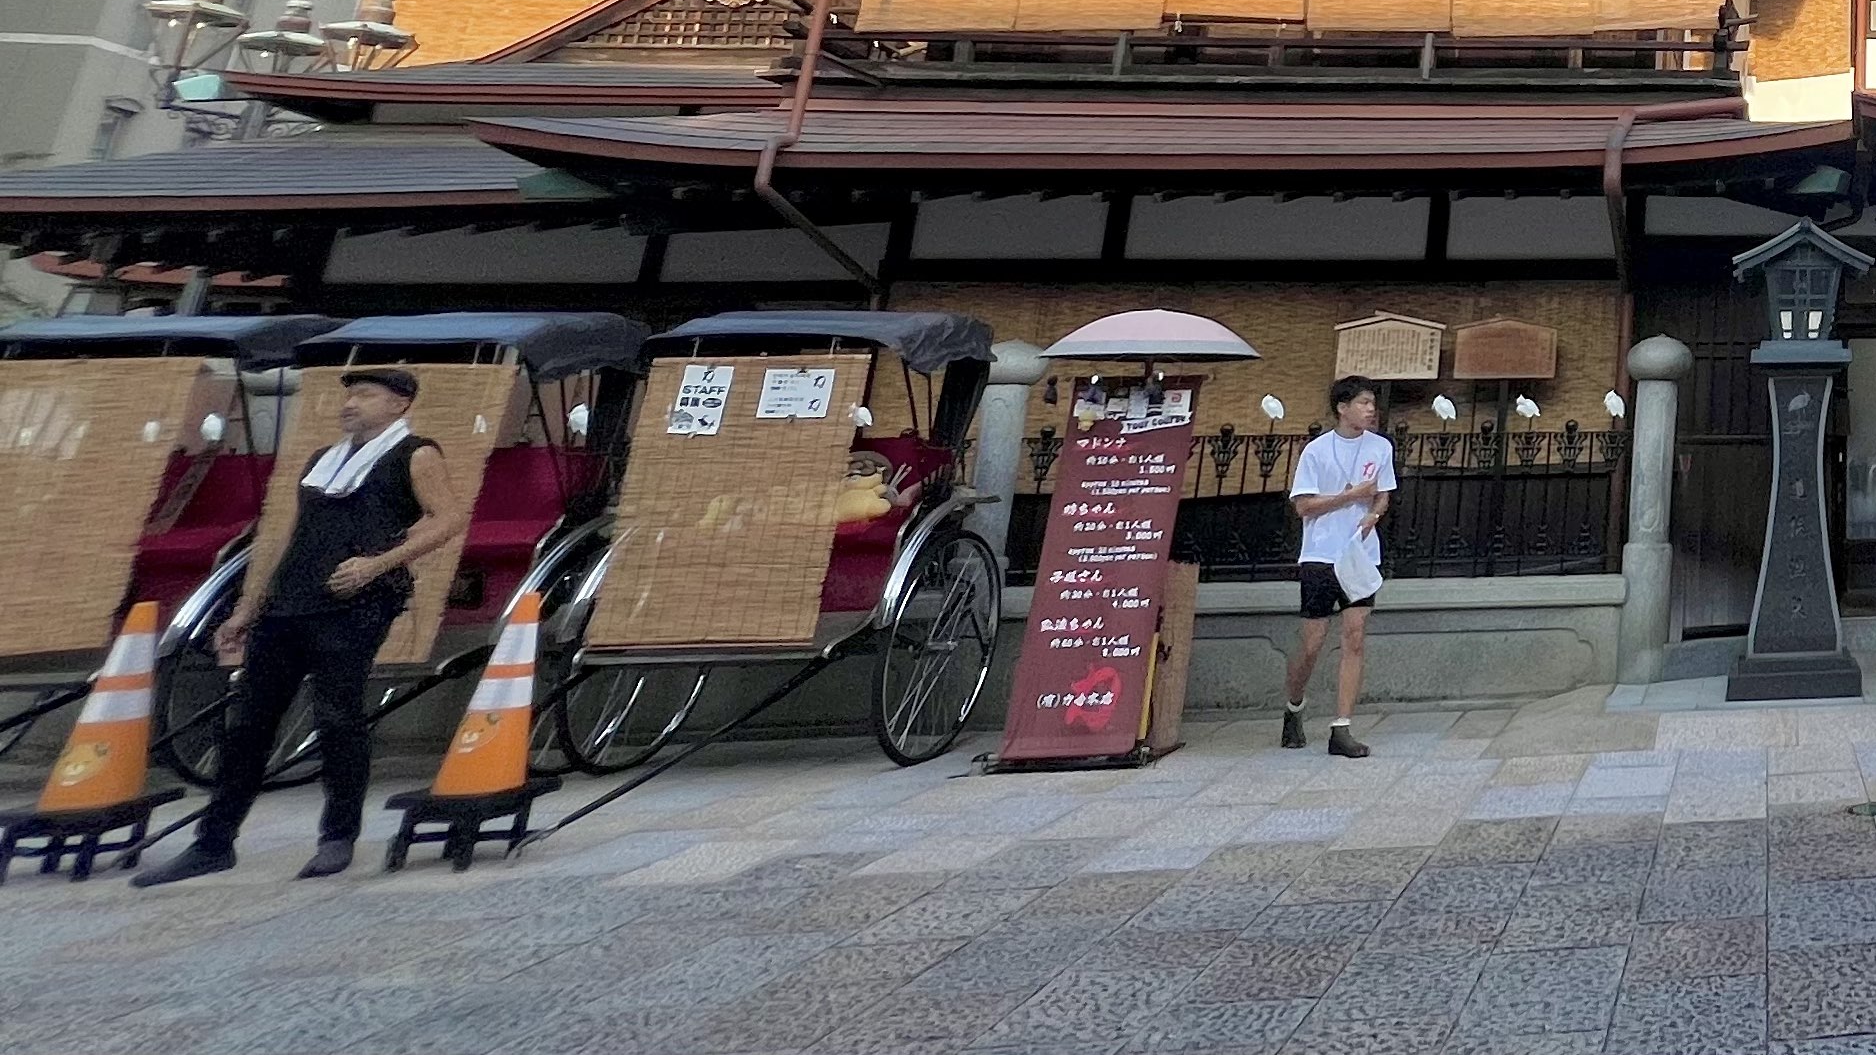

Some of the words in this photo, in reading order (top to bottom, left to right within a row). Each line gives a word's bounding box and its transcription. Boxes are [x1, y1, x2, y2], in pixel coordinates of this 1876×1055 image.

[682, 385, 726, 395] STAFF
[1076, 437, 1127, 450] マドンナ
